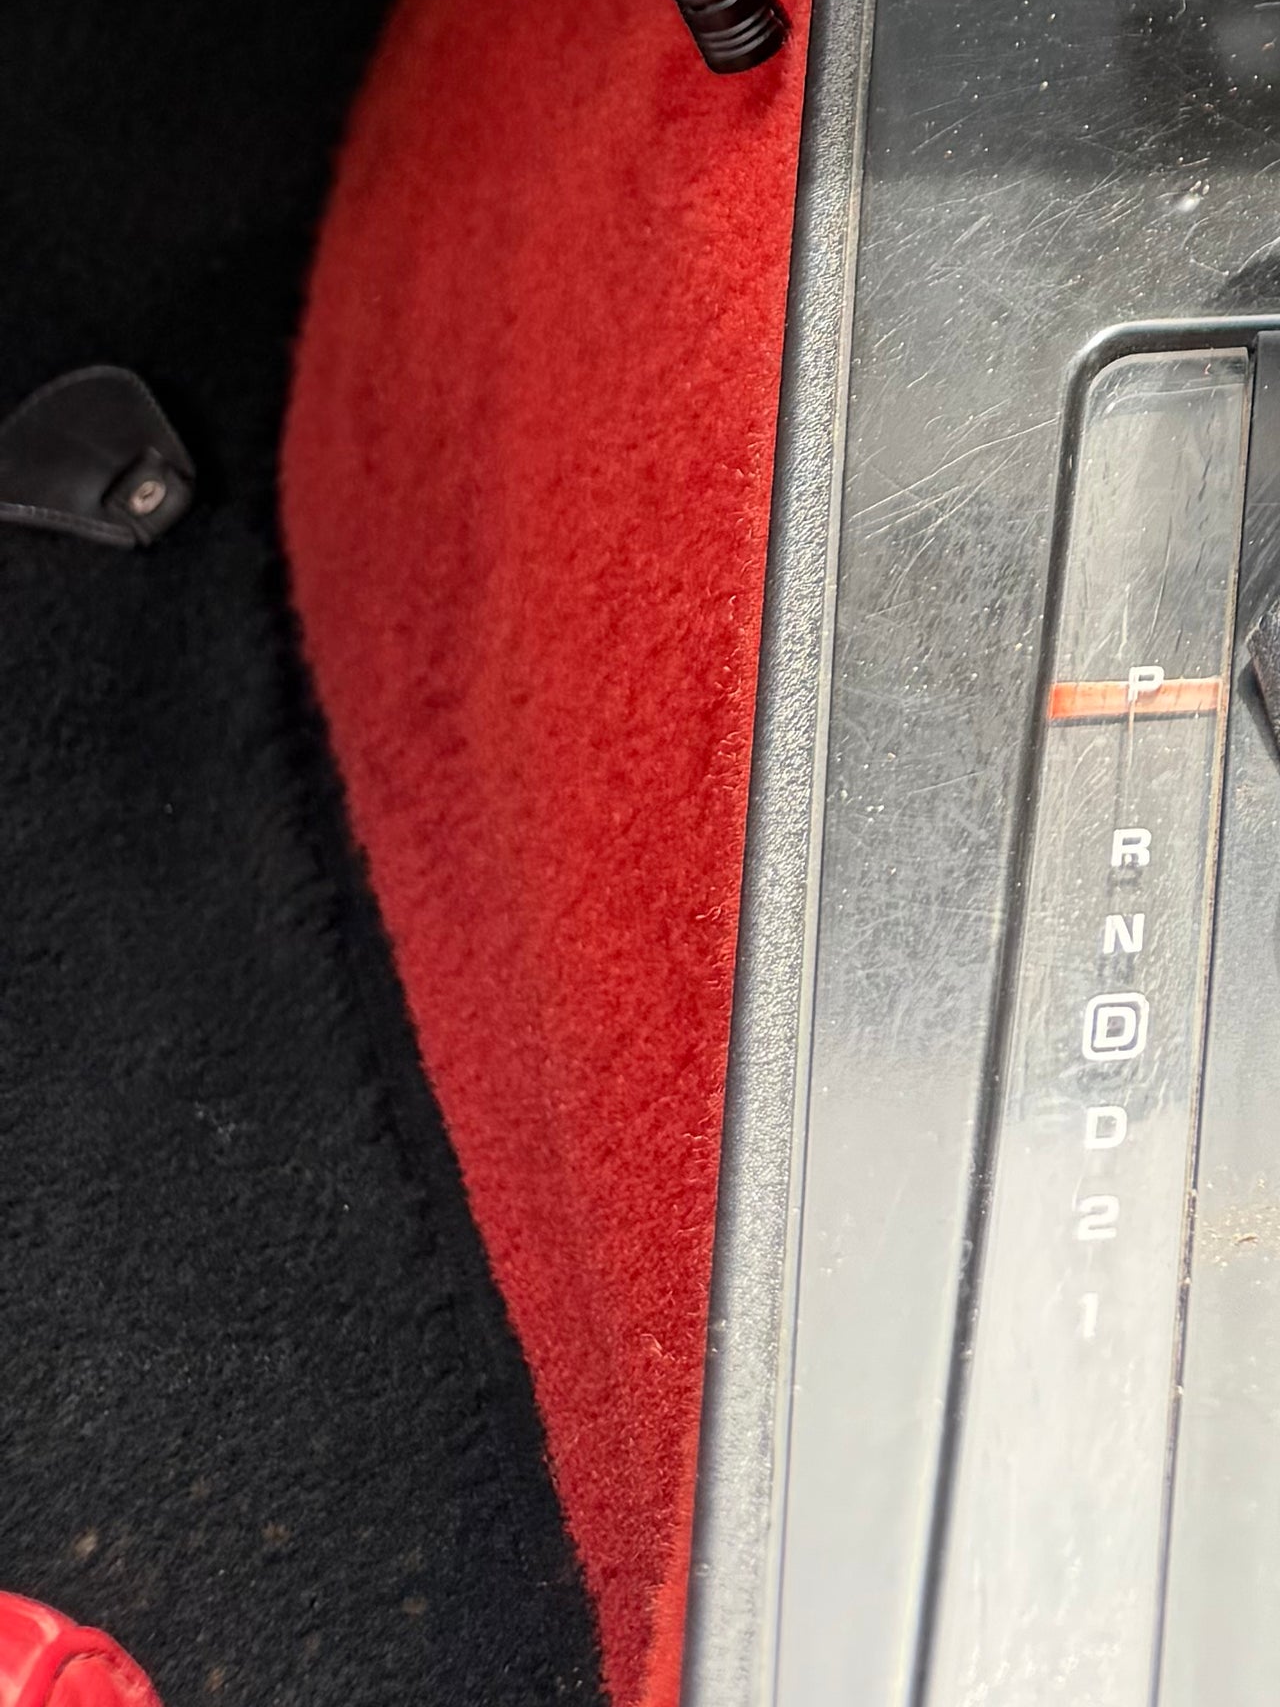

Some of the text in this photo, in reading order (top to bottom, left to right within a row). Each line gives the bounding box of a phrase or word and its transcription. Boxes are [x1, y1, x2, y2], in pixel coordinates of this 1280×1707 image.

[1128, 666, 1164, 701] P
[1110, 828, 1152, 867] R
[1103, 913, 1145, 954] N
[1085, 1105, 1128, 1149] D
[1077, 1195, 1120, 1240] 2
[1080, 1292, 1098, 1337] 1
